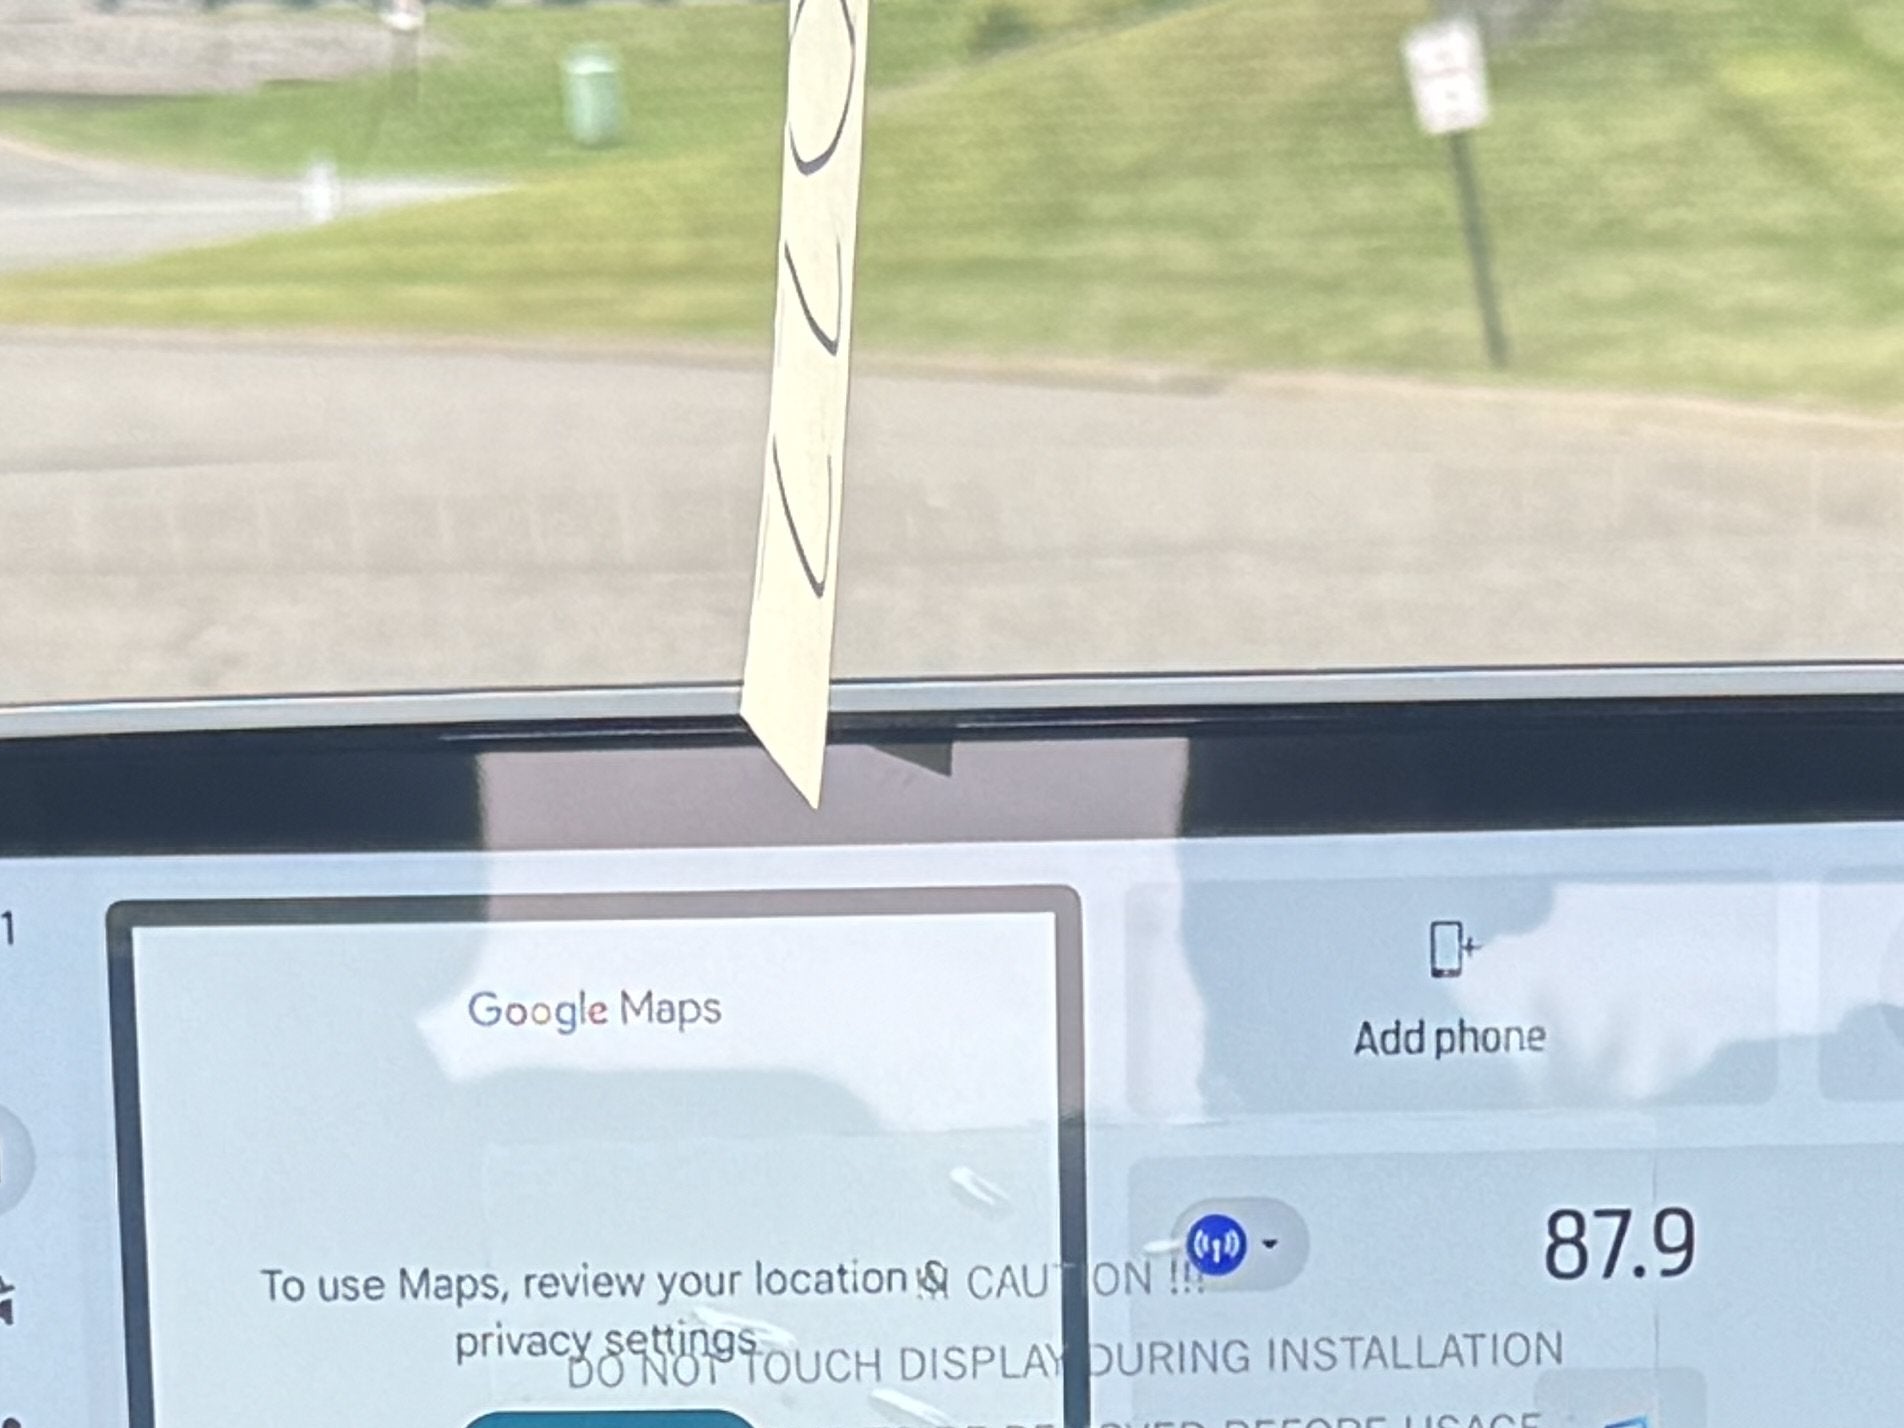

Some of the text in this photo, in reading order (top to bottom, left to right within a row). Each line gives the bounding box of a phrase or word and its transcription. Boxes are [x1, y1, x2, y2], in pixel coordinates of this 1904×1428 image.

[468, 989, 723, 1035] Google Maps
[1354, 1018, 1547, 1060] Add phone
[1545, 1206, 1695, 1281] 87.9
[259, 1268, 306, 1301] To
[318, 1275, 385, 1302] use
[399, 1267, 509, 1308] Maps,
[524, 1262, 645, 1298] review
[656, 1268, 742, 1305] your
[755, 1259, 907, 1297] location
[456, 1318, 758, 1366] privacy settings
[568, 1330, 1564, 1389] DO NOT TOUCH DISPLAY DURING INSTALLATION
